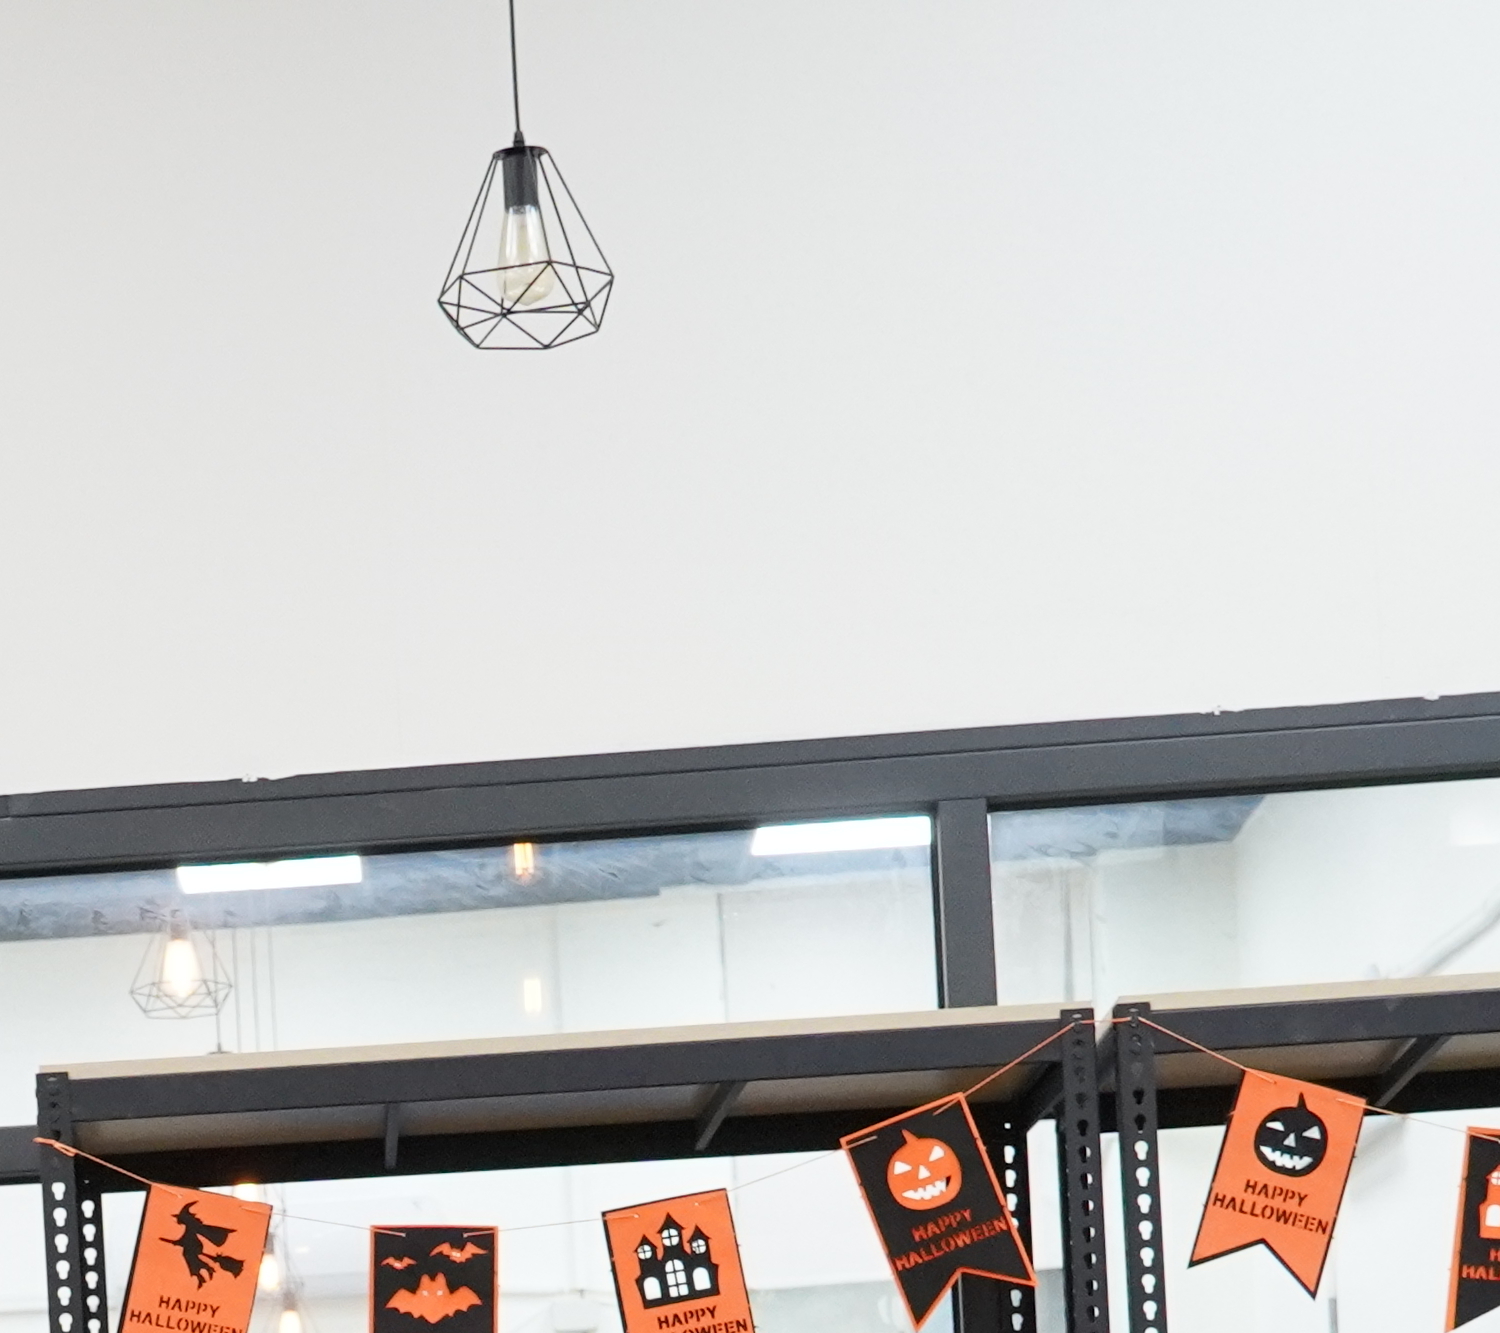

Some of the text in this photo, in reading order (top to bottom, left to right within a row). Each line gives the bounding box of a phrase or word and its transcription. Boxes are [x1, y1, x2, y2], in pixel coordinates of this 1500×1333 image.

[1243, 1178, 1308, 1208] HAPPY
[911, 1208, 972, 1242] HAPPY
[1212, 1192, 1329, 1235] HALLOWEEN
[893, 1215, 1008, 1271] HALLOWEEN
[158, 1294, 220, 1318] HAPPY
[656, 1305, 717, 1330] HAPPY
